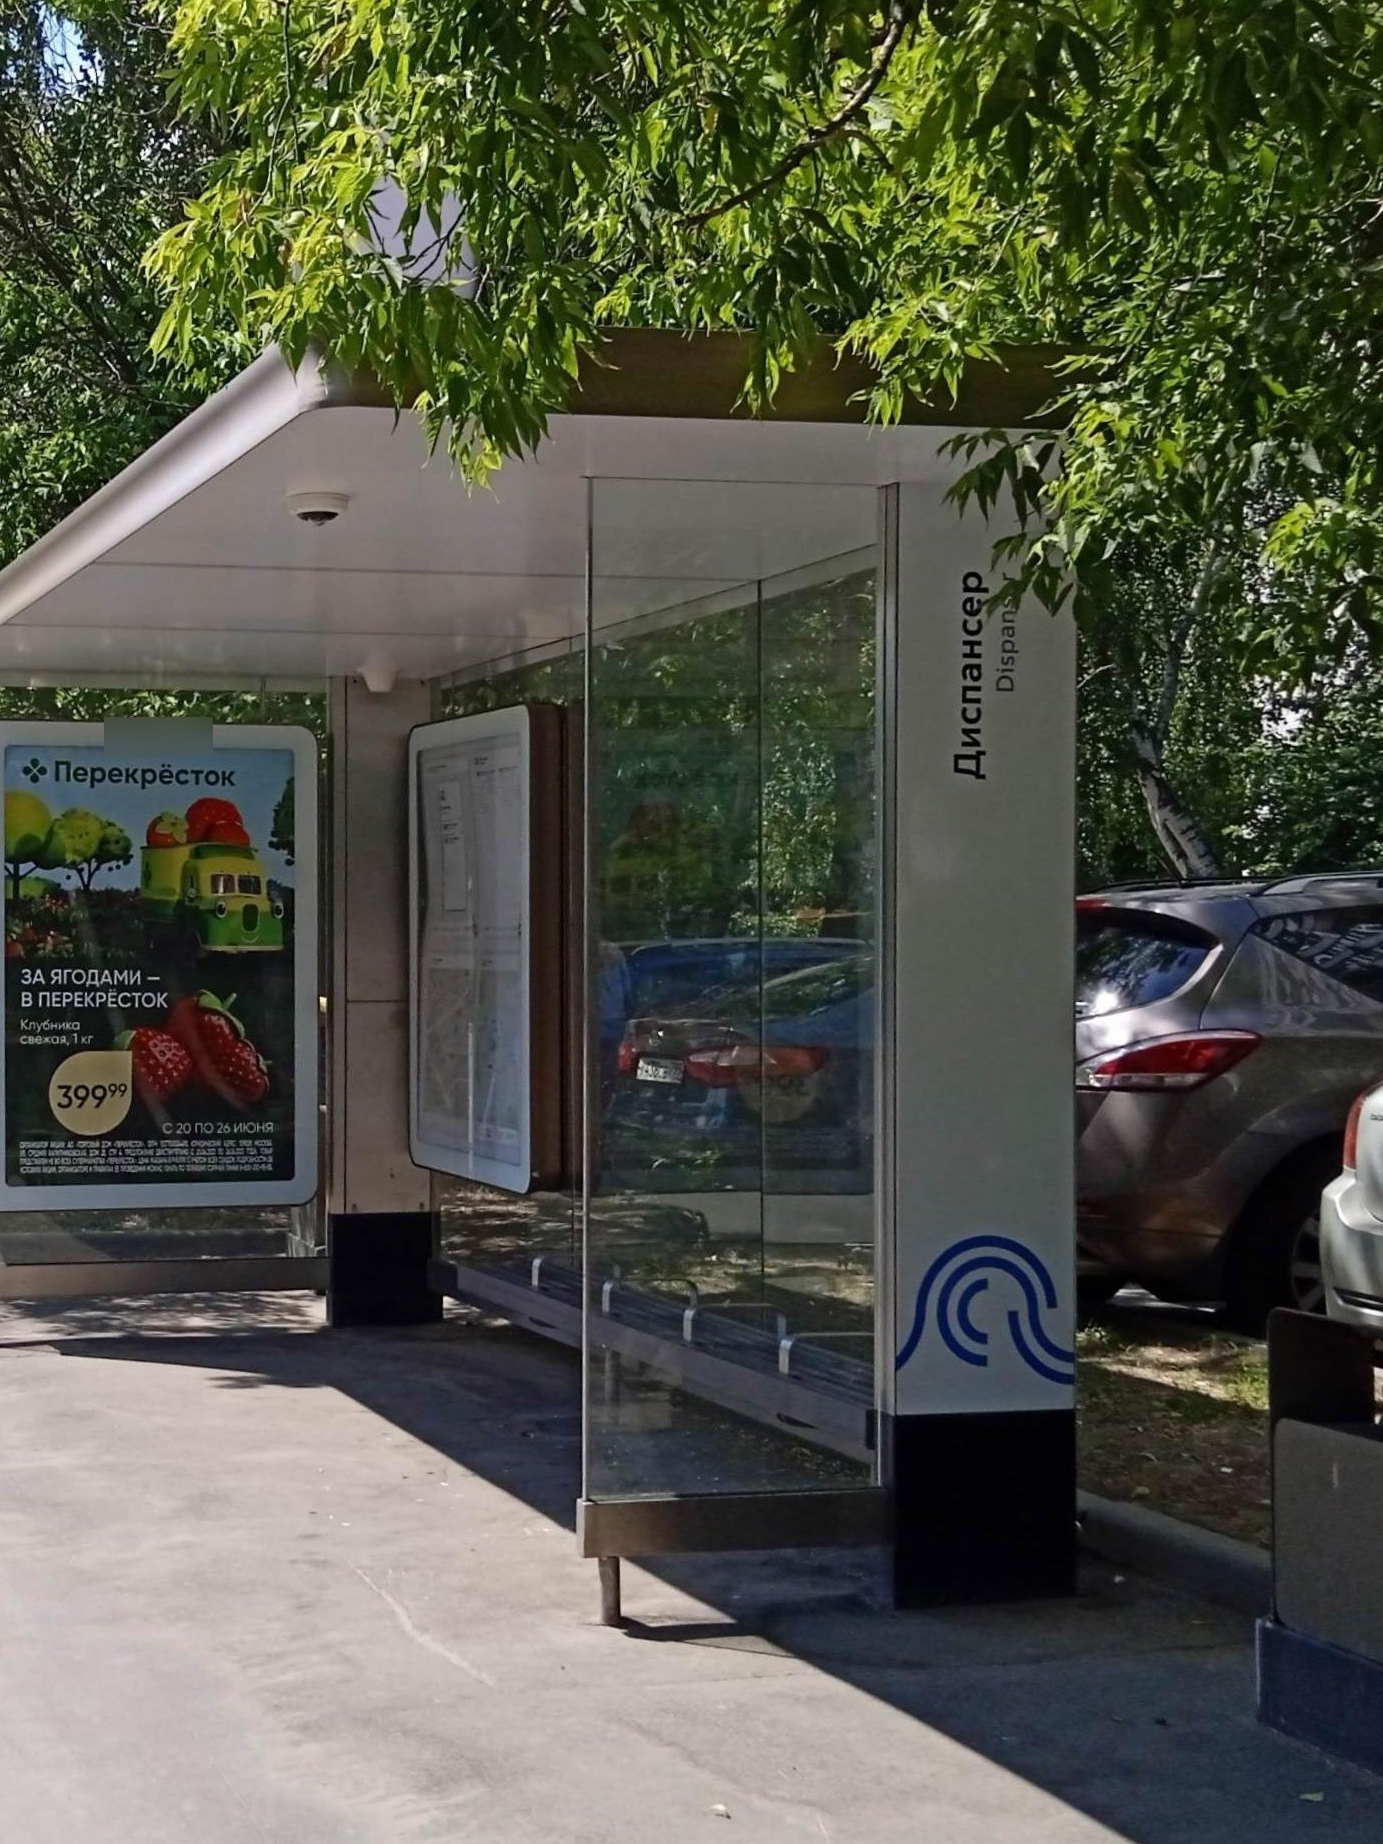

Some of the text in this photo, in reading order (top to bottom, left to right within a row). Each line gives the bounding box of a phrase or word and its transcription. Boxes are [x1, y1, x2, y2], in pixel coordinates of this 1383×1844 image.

[996, 572, 1019, 692] Dispansr
[953, 571, 989, 780] Диспансер
[54, 758, 235, 790] Перекрёсток
[21, 968, 46, 985] ЗА
[50, 968, 142, 988] ЯГОДАМИ
[21, 988, 168, 1008] В ПЕРЕКРЁСТОК
[20, 1018, 81, 1034] Клубника
[80, 1034, 94, 1045] кг
[162, 1121, 275, 1134] С 20 ПО 26 ИЮНЯ
